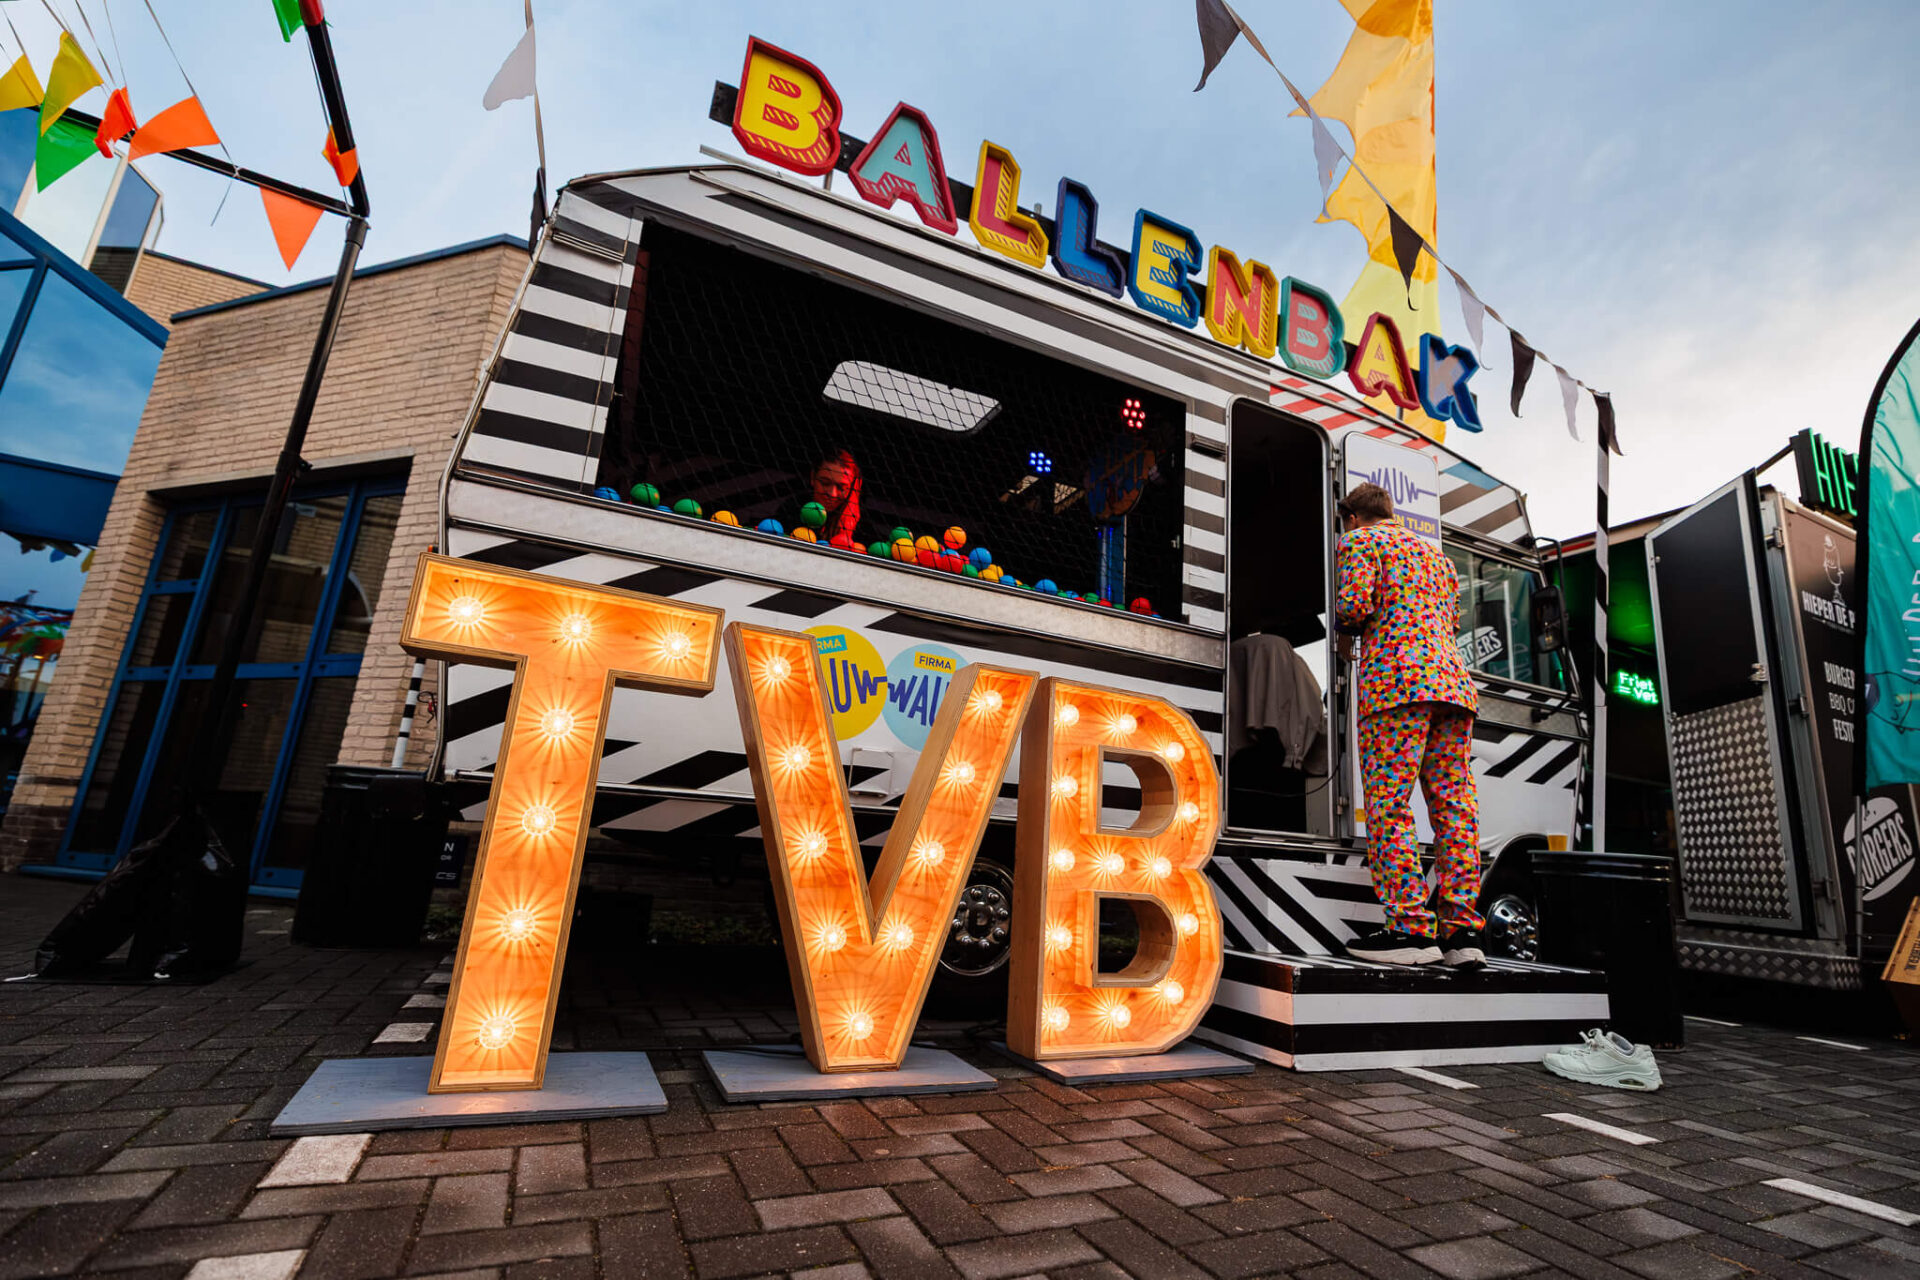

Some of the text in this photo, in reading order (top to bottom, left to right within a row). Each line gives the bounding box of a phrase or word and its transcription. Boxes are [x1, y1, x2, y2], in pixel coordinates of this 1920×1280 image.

[731, 34, 1483, 433] BALLENBAK
[1807, 427, 1860, 516] HIE
[1406, 517, 1436, 536] TIJD!
[1801, 590, 1836, 622] HIEPER
[1834, 605, 1849, 626] DE
[816, 638, 843, 652] RMA
[918, 655, 952, 670] FIRMA
[827, 658, 887, 714] UW
[1618, 671, 1655, 692] Friet
[1632, 687, 1659, 705] Vet
[1828, 692, 1847, 716] BBQ
[400, 552, 1224, 1094] TVB
